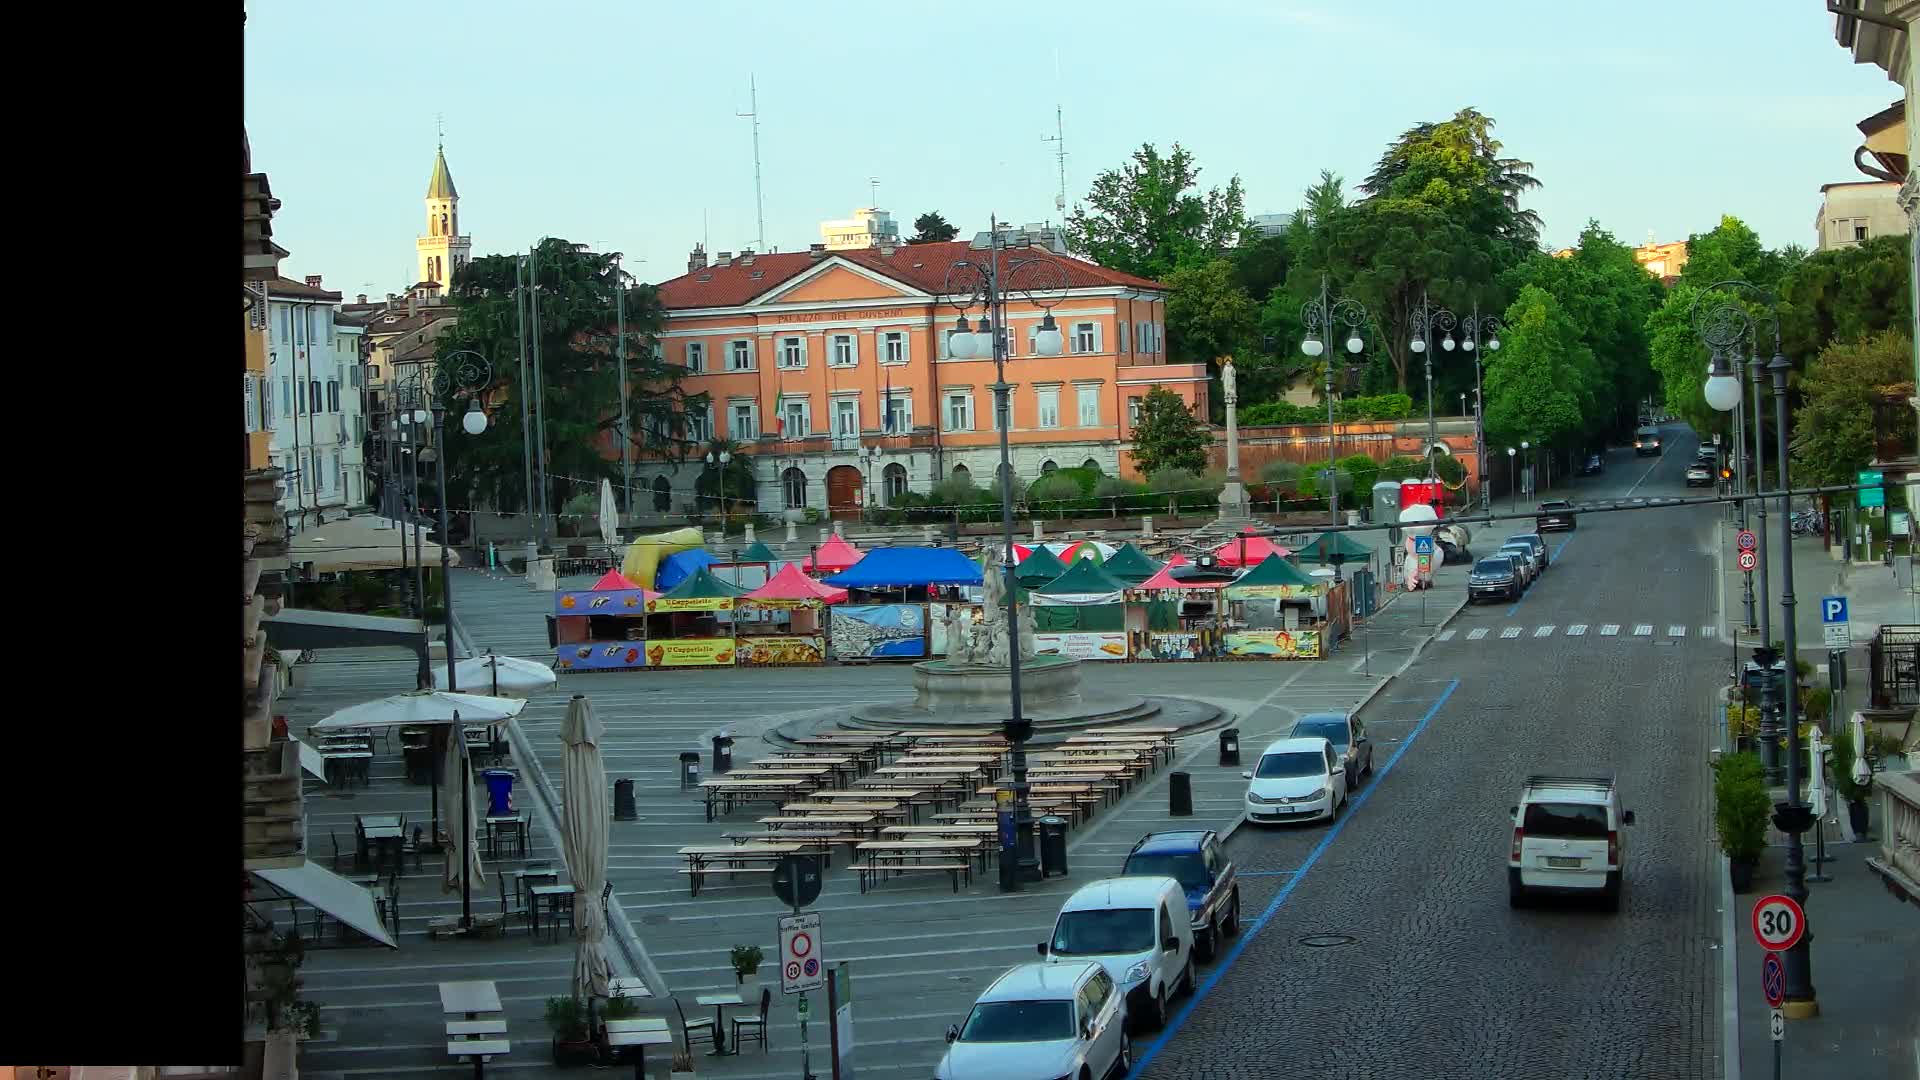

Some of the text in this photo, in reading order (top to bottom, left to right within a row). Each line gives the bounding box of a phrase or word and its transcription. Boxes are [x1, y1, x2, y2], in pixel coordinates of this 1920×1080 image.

[778, 308, 904, 324] PALAZZO DEL GOVERNO
[1742, 556, 1753, 565] 20
[1827, 600, 1843, 621] P
[1762, 910, 1792, 936] 30
[789, 966, 798, 976] 20
